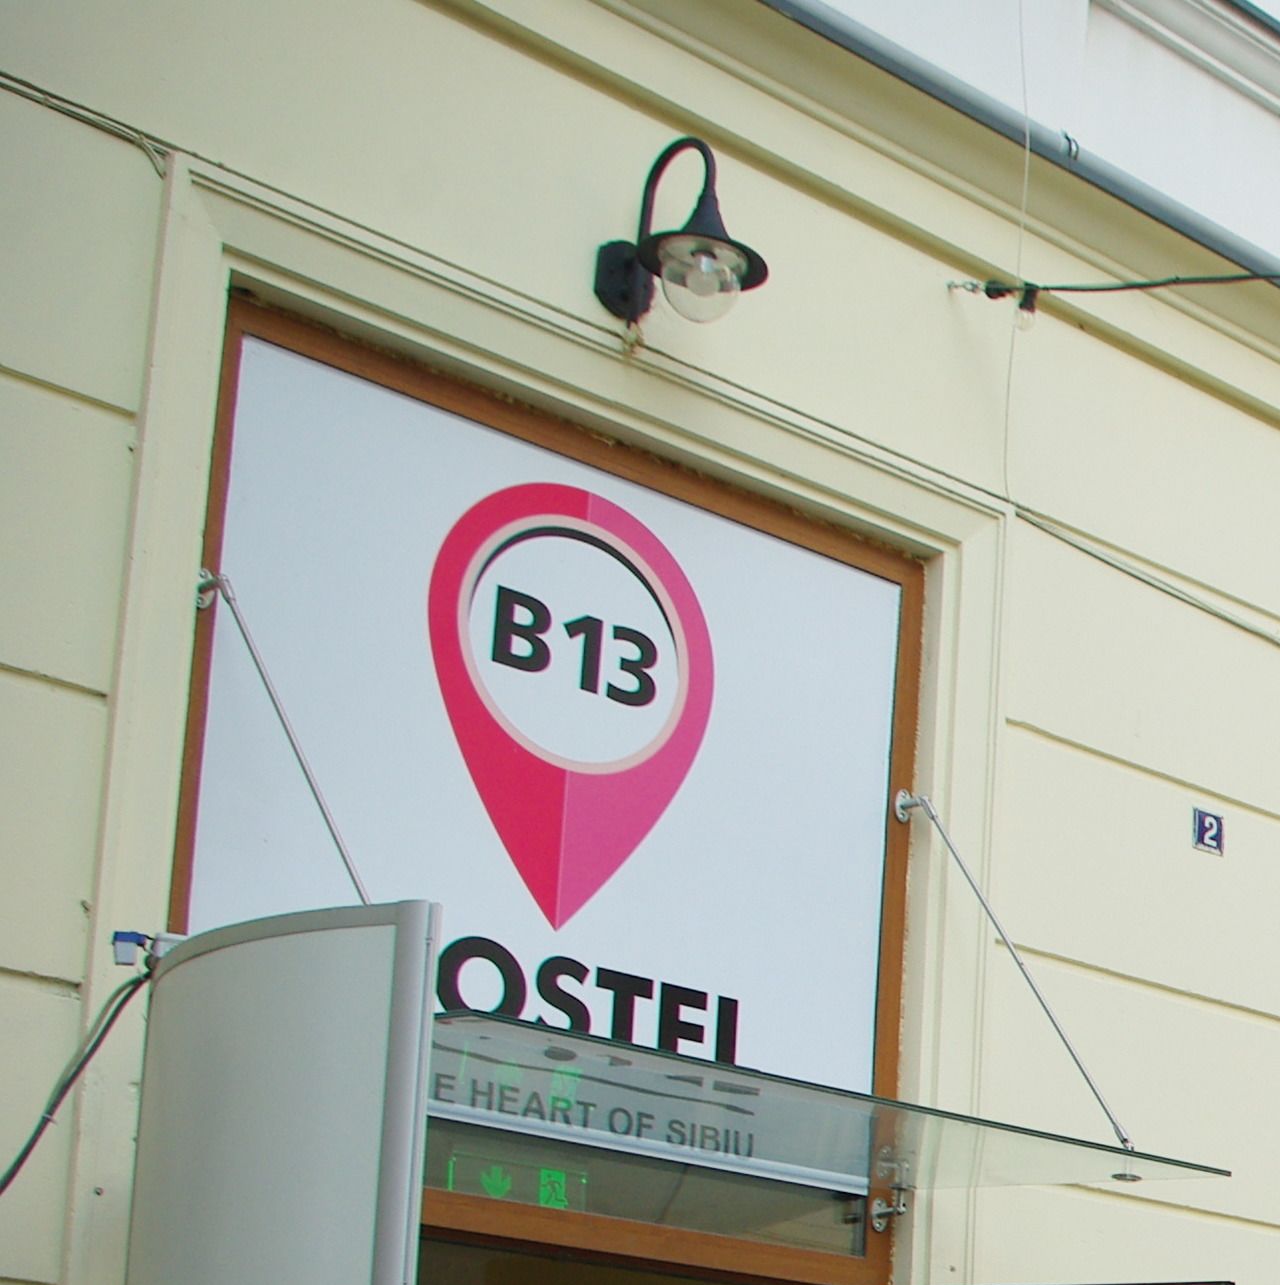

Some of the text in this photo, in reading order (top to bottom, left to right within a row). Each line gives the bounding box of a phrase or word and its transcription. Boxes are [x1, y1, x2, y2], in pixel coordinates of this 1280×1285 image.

[490, 584, 658, 708] B13
[1203, 815, 1218, 848] 2
[436, 936, 739, 1067] OSTEL
[470, 1078, 597, 1130] HEART
[608, 1107, 655, 1139] OF
[666, 1118, 755, 1158] SIBIU
